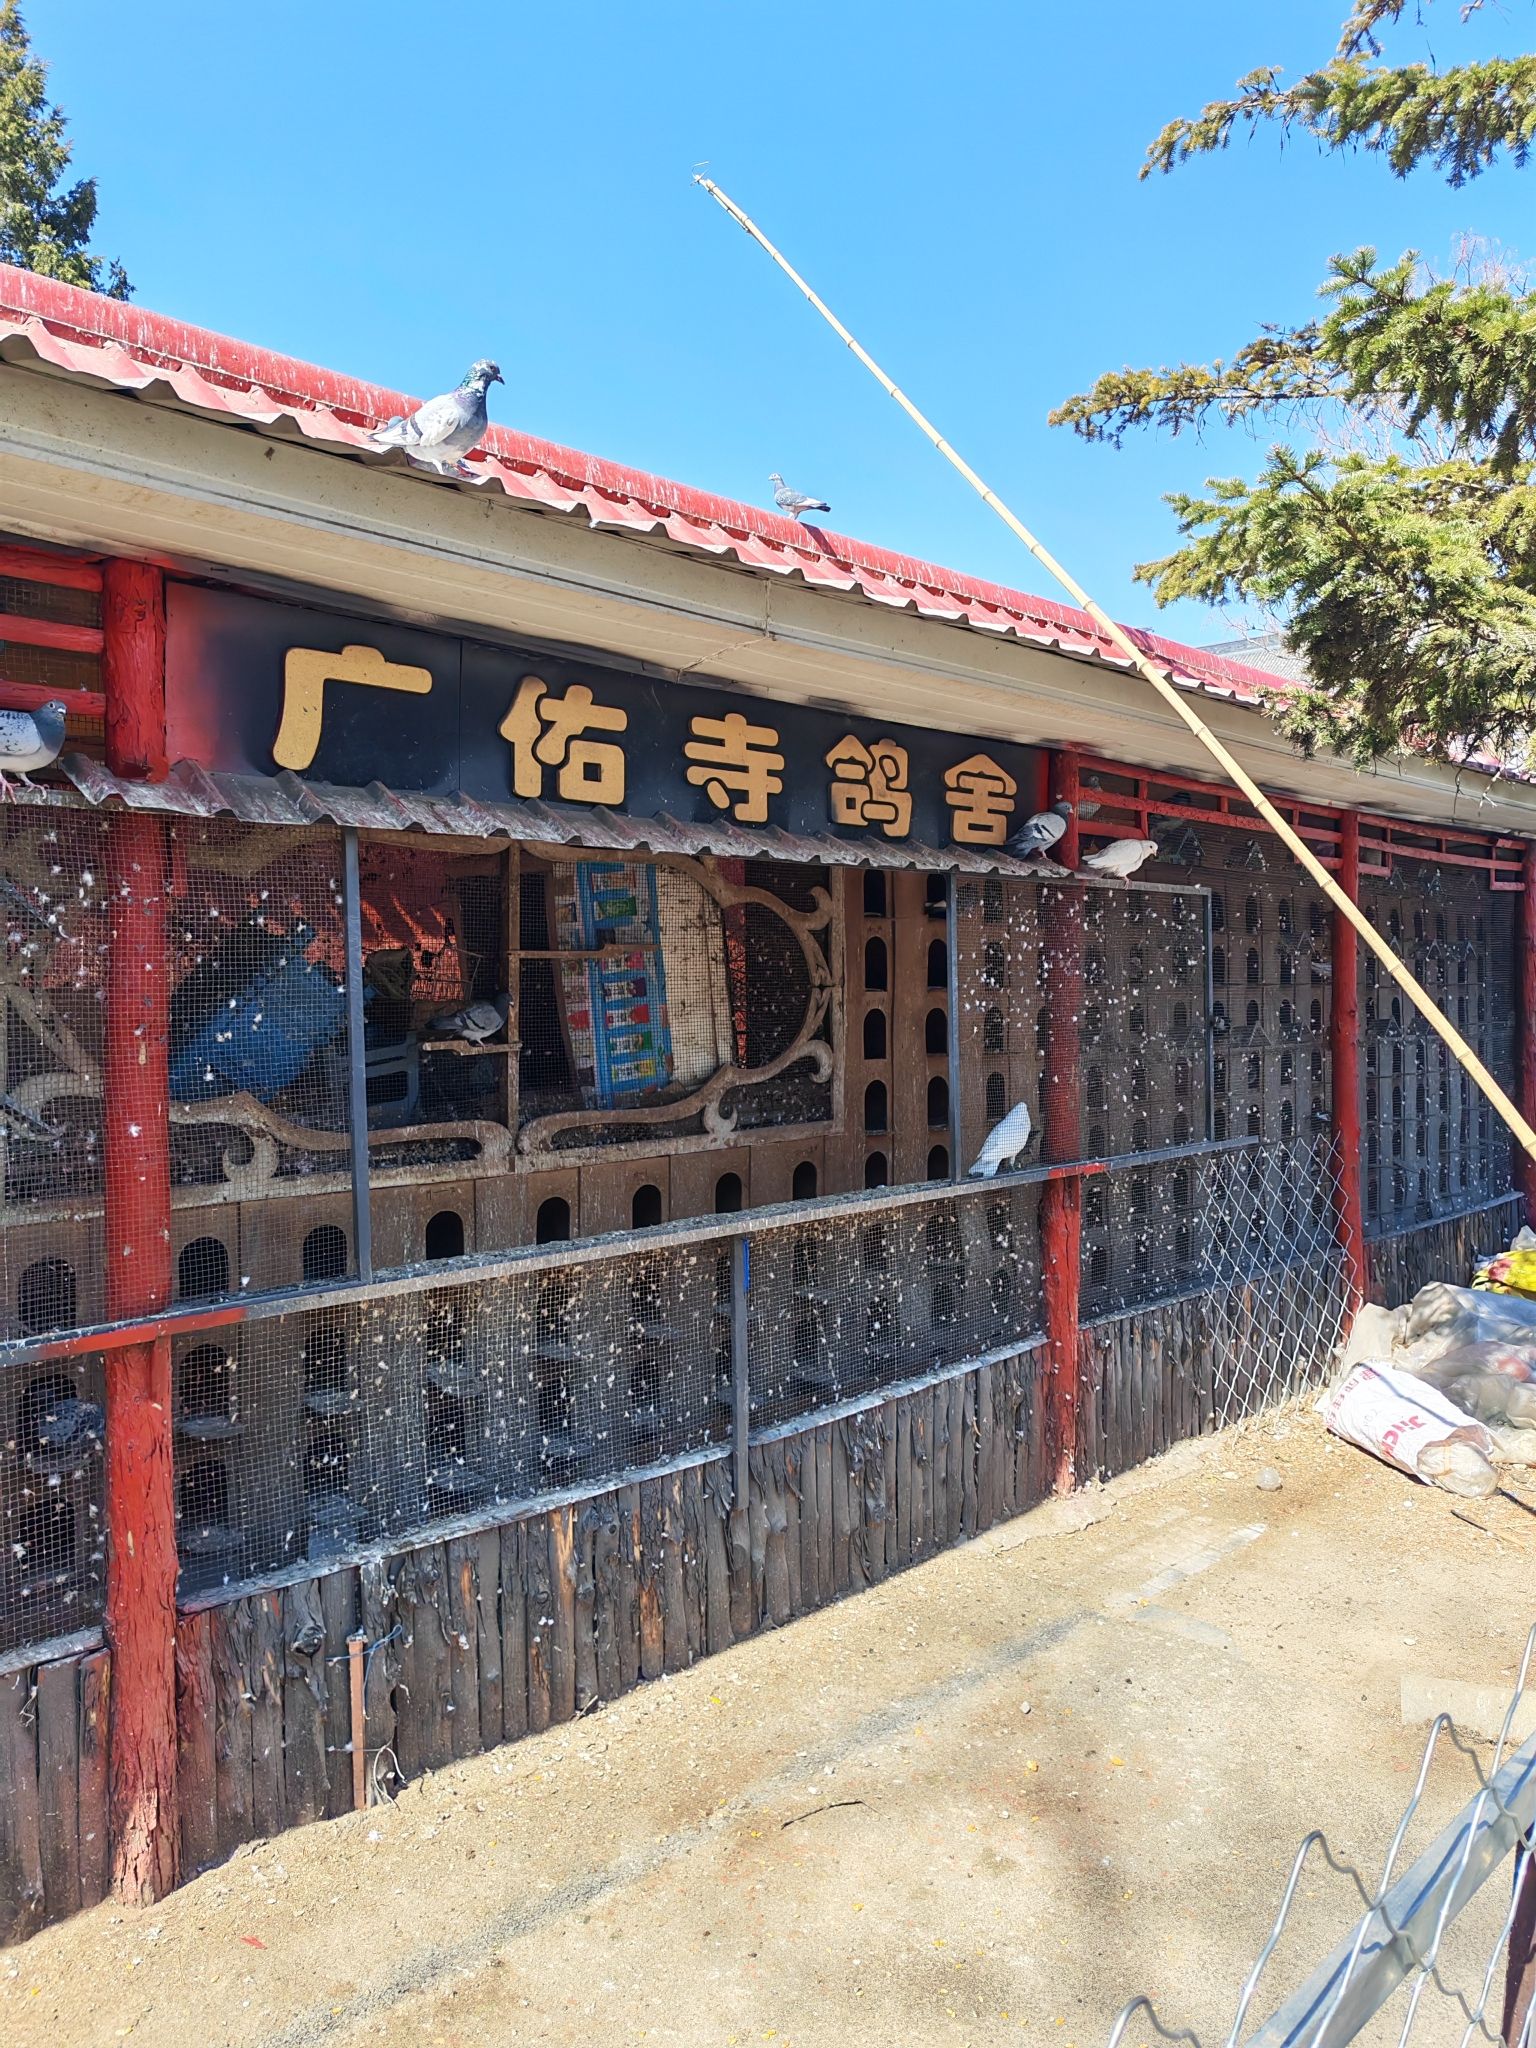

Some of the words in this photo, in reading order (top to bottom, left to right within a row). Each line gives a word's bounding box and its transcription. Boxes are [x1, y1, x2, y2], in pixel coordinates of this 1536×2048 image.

[272, 644, 1018, 845] 广佑寺鸽舍
